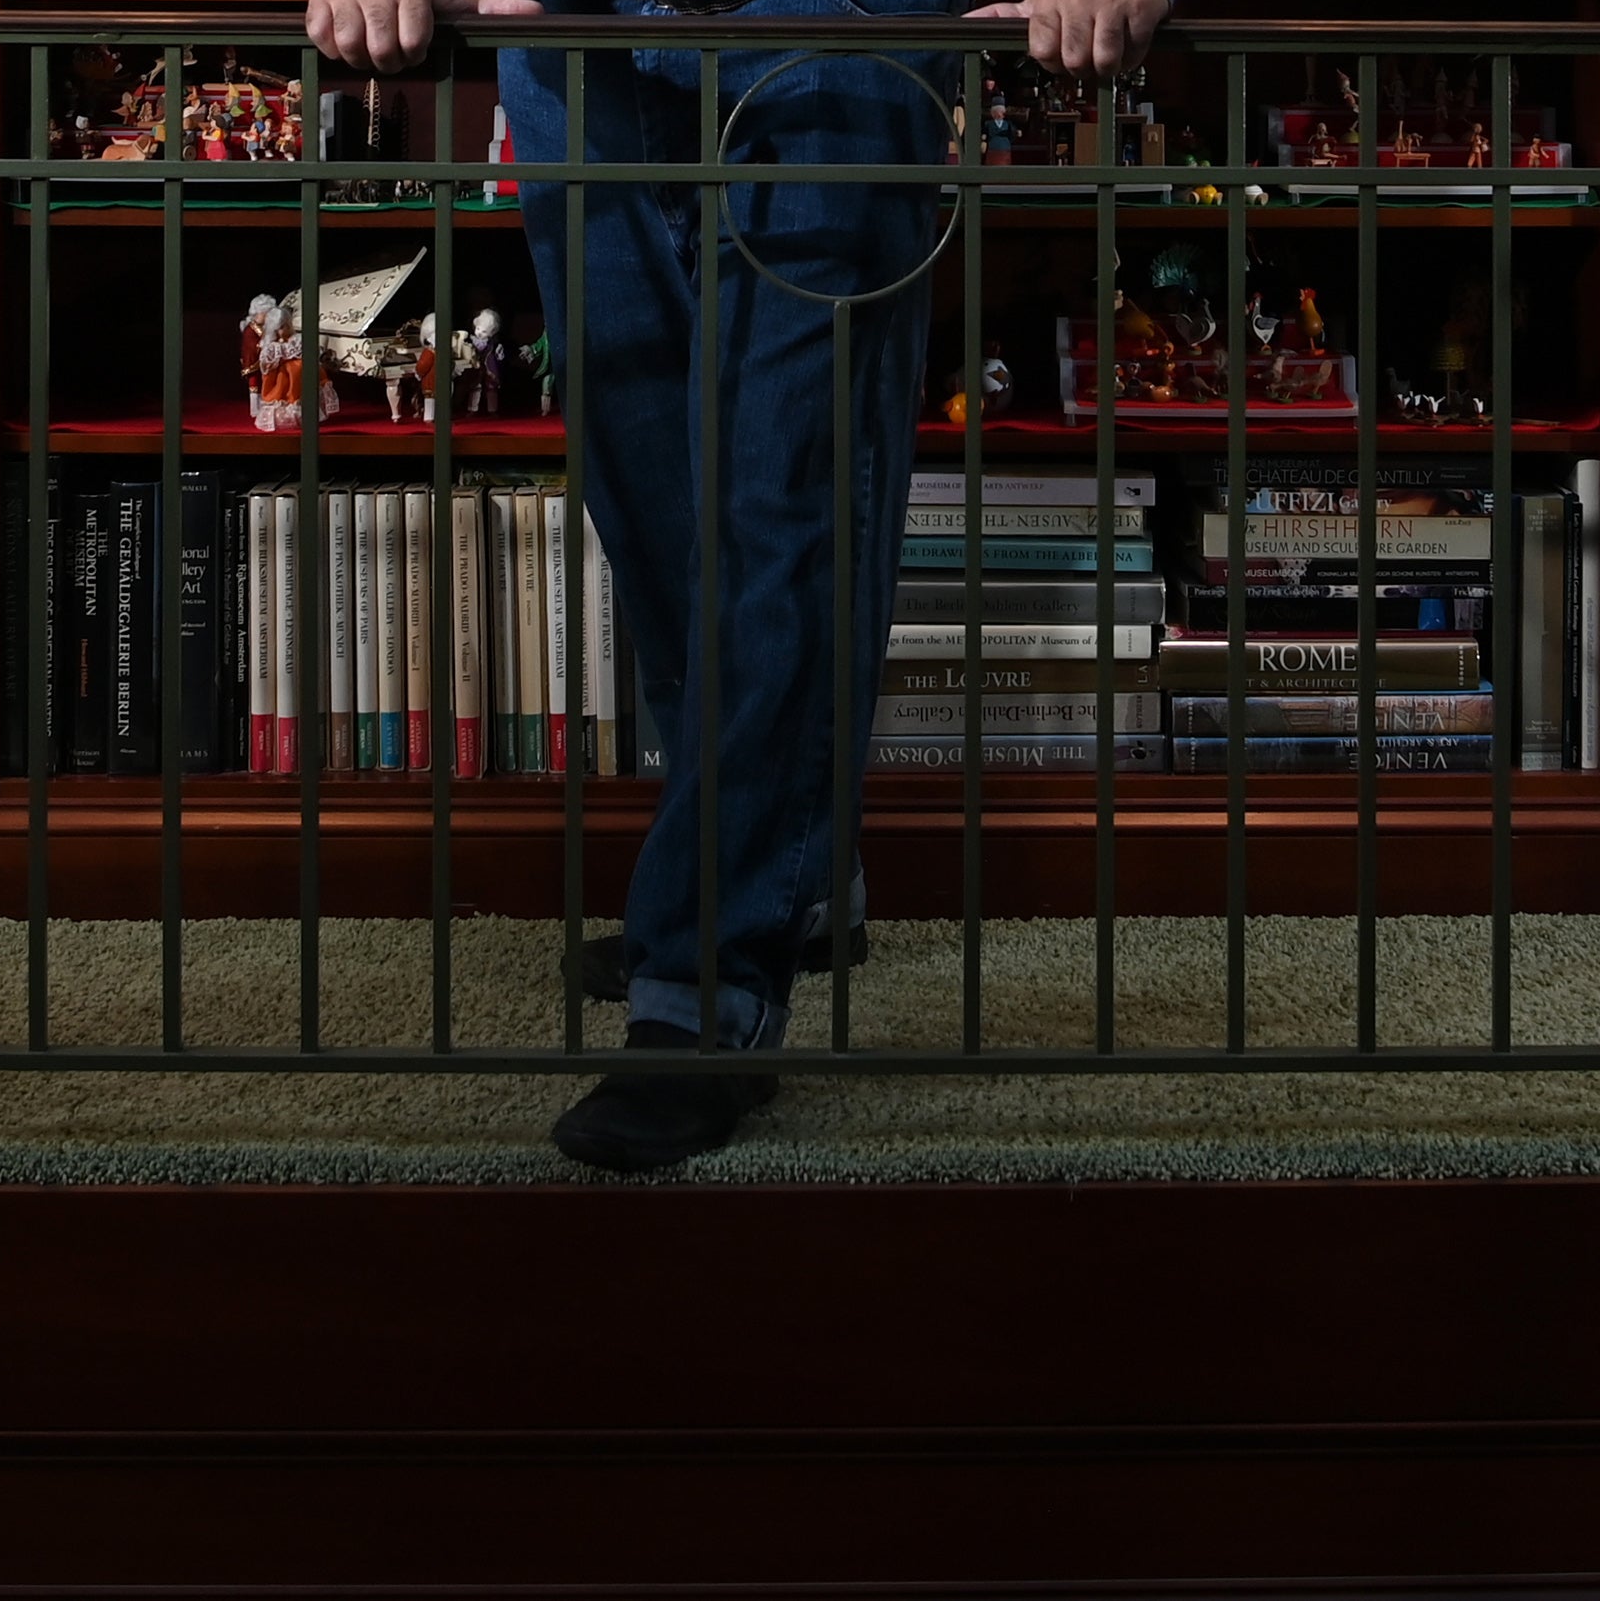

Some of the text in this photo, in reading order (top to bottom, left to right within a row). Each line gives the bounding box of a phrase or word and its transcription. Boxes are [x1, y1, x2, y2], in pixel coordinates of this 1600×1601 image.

[1255, 492, 1335, 511] UFFIZI
[98, 529, 108, 557] THE
[259, 526, 267, 546] THE
[410, 530, 418, 548] THE
[552, 526, 562, 546] THE
[1264, 520, 1414, 538] HIRSHHRN
[74, 529, 85, 587] MUSEUM
[460, 534, 469, 554] THE
[993, 550, 1029, 559] FROM
[1293, 542, 1320, 553] AND
[1396, 543, 1447, 554] GARDEN
[84, 508, 96, 616] METROPOLITAN
[460, 558, 469, 589] PRADO
[525, 530, 534, 592] THE LOUVRE
[335, 524, 344, 658] ALTE PINAKOTHEK MUNICH
[359, 530, 368, 644] THE MUSEUMS OF PARIS
[386, 529, 395, 676] NATIONAL GALLERY LONDON
[411, 589, 419, 626] MADRID
[461, 595, 469, 633] MADRID
[600, 560, 611, 661] MUSEUMS OF FRANCE
[117, 498, 134, 737] THE GEMÄLDEGALERIE BERLIN
[235, 564, 246, 682] Rijksmuseum Amsterdam
[259, 622, 267, 679] AMSTERDAM
[554, 620, 563, 678] AMSTERDAM
[902, 635, 942, 645] from the
[1041, 636, 1091, 645] Museum of
[461, 642, 470, 672] Volume
[1258, 645, 1358, 672] ROME
[904, 676, 937, 688] THE
[894, 705, 953, 723] Gallery
[1052, 747, 1085, 759] THE
